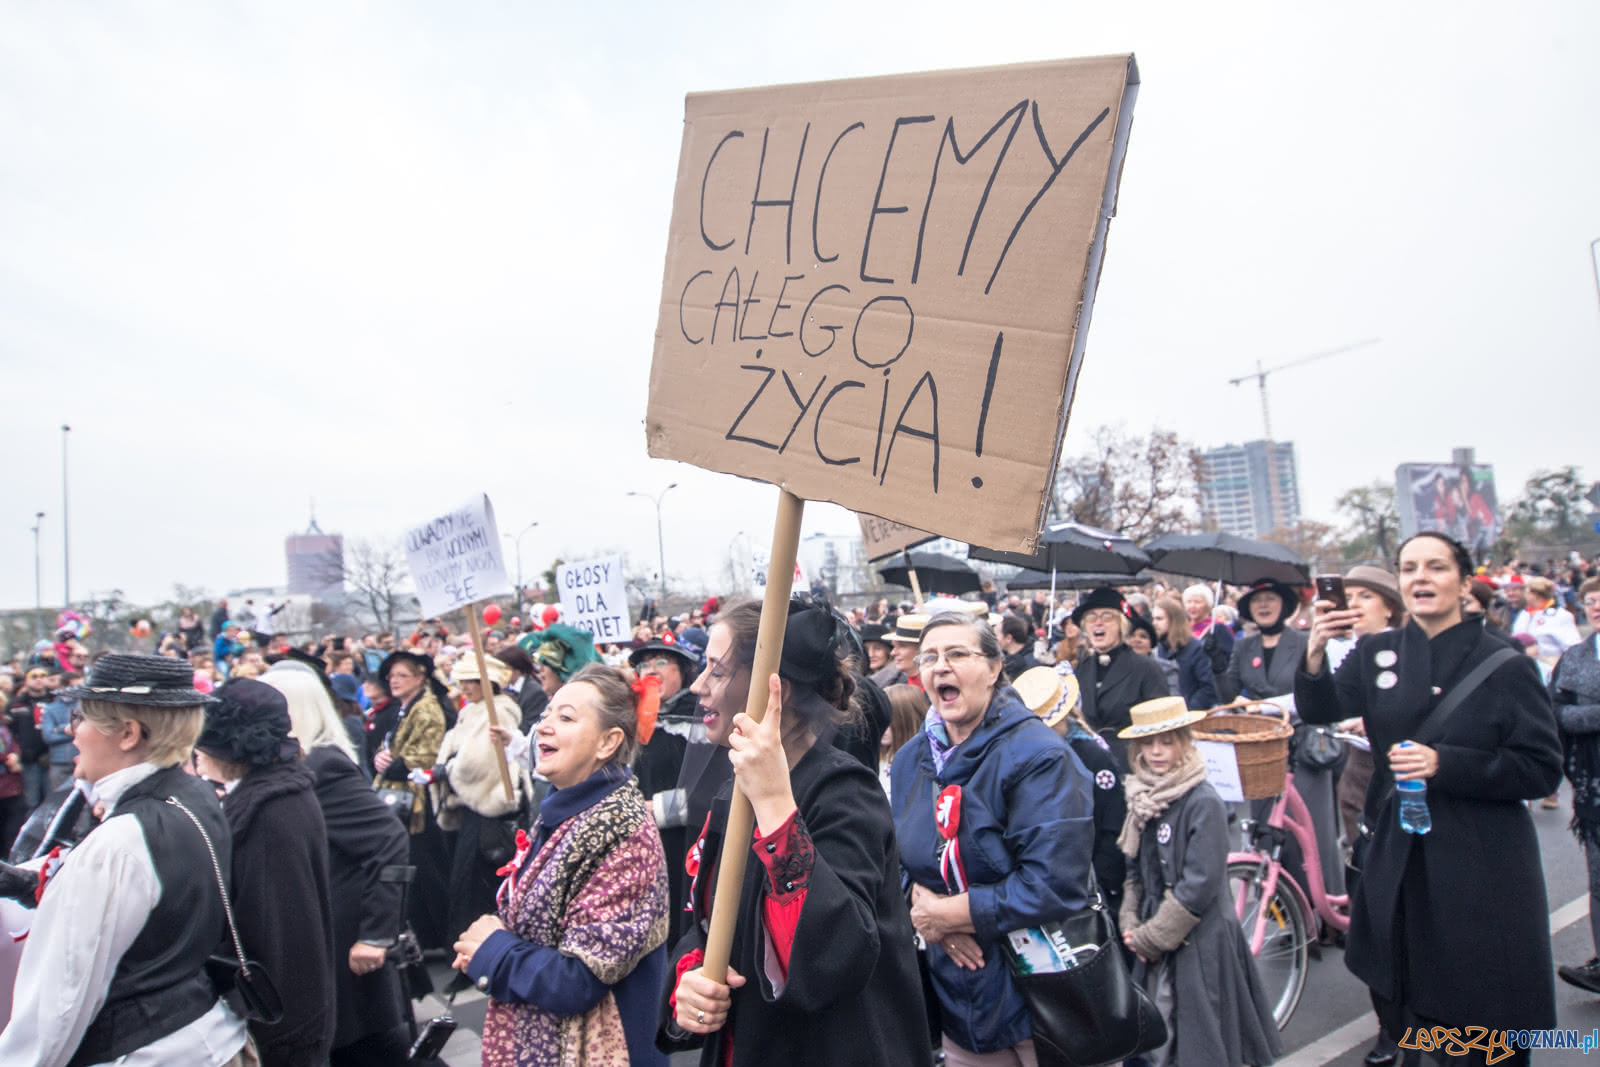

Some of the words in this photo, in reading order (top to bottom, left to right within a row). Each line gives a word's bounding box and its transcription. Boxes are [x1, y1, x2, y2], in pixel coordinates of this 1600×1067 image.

[700, 99, 1111, 294] CHCEMY
[680, 266, 914, 369] CAŁEGO
[565, 562, 610, 589] GŁOSY
[576, 592, 608, 614] DLA
